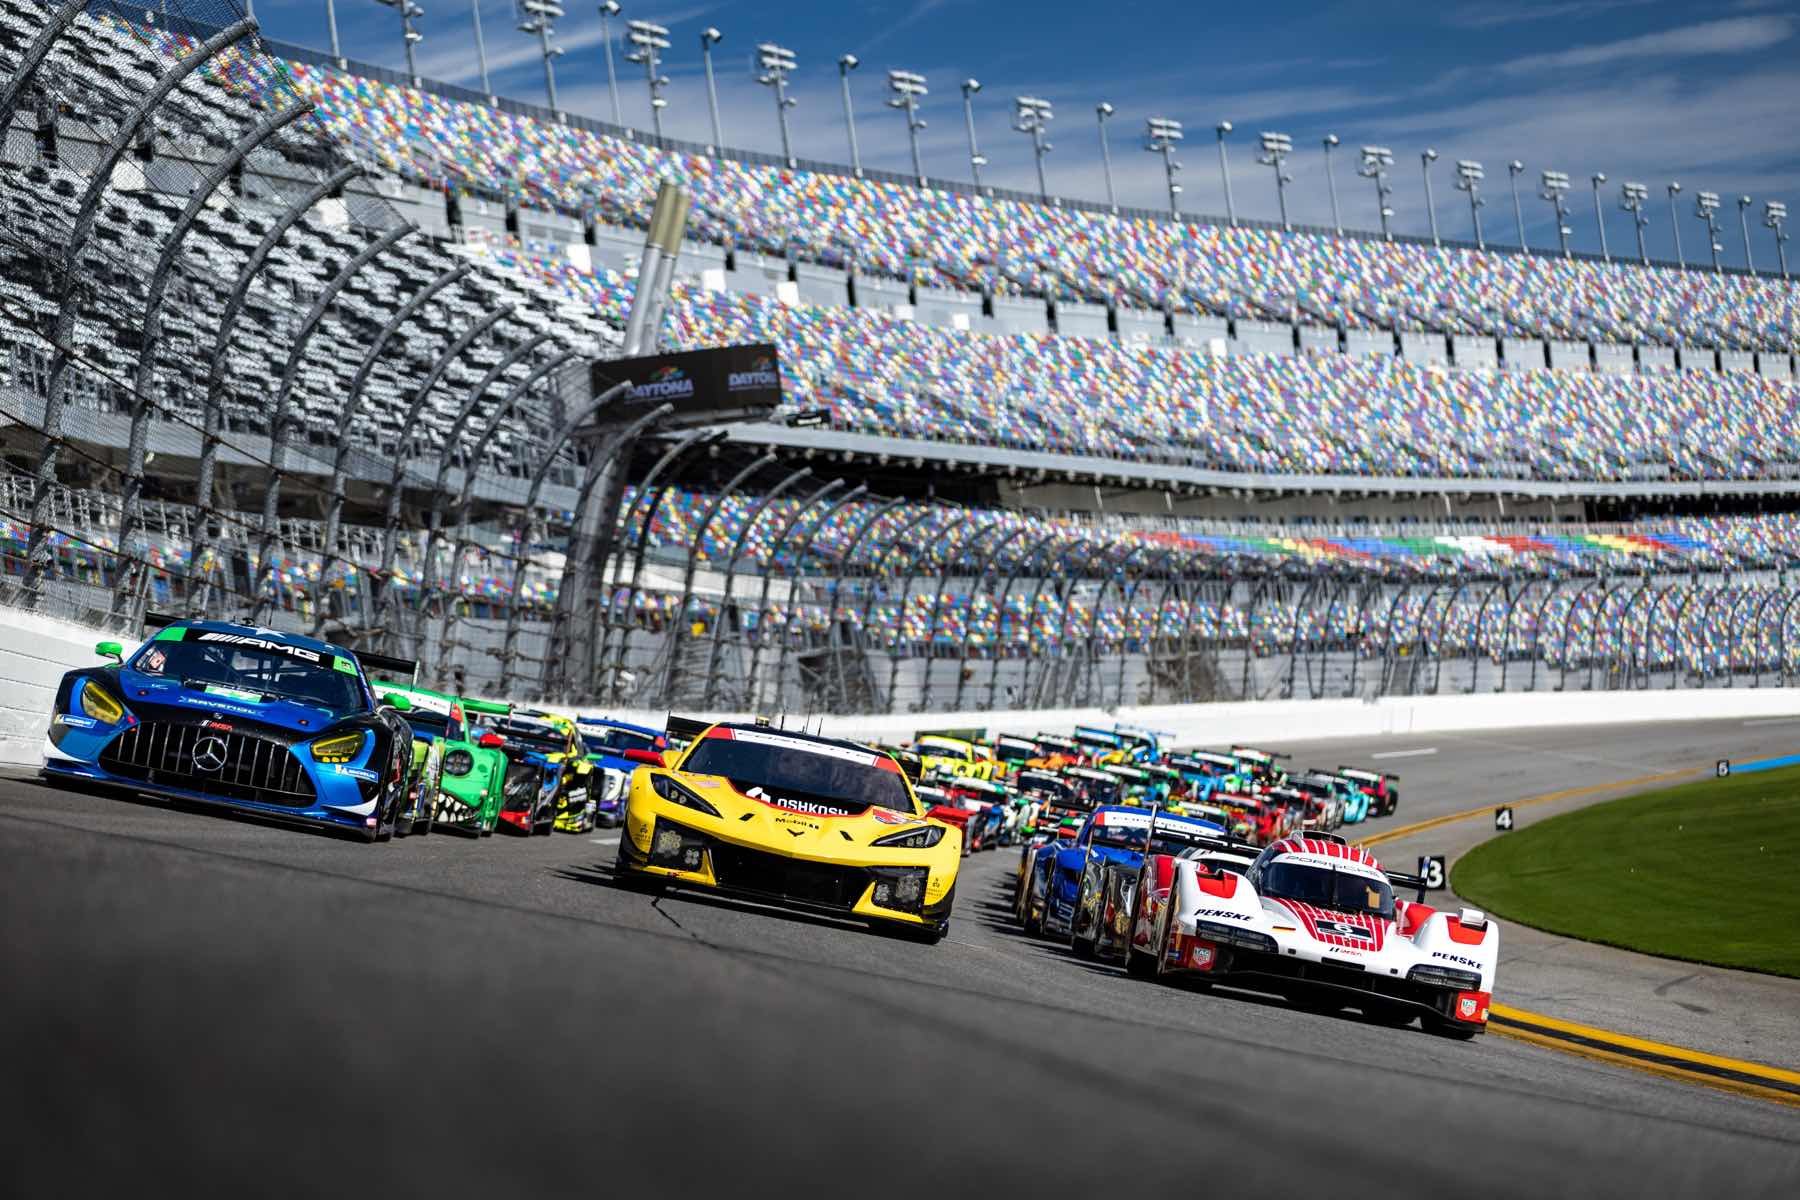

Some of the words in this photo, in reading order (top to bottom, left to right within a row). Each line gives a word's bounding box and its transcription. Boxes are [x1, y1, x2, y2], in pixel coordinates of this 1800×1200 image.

[728, 372, 778, 386] DAYTON
[239, 638, 320, 662] AMG
[1496, 810, 1512, 829] 4
[1426, 860, 1443, 888] 3
[1194, 908, 1254, 922] PENSKE
[1431, 951, 1484, 970] PENSKE
